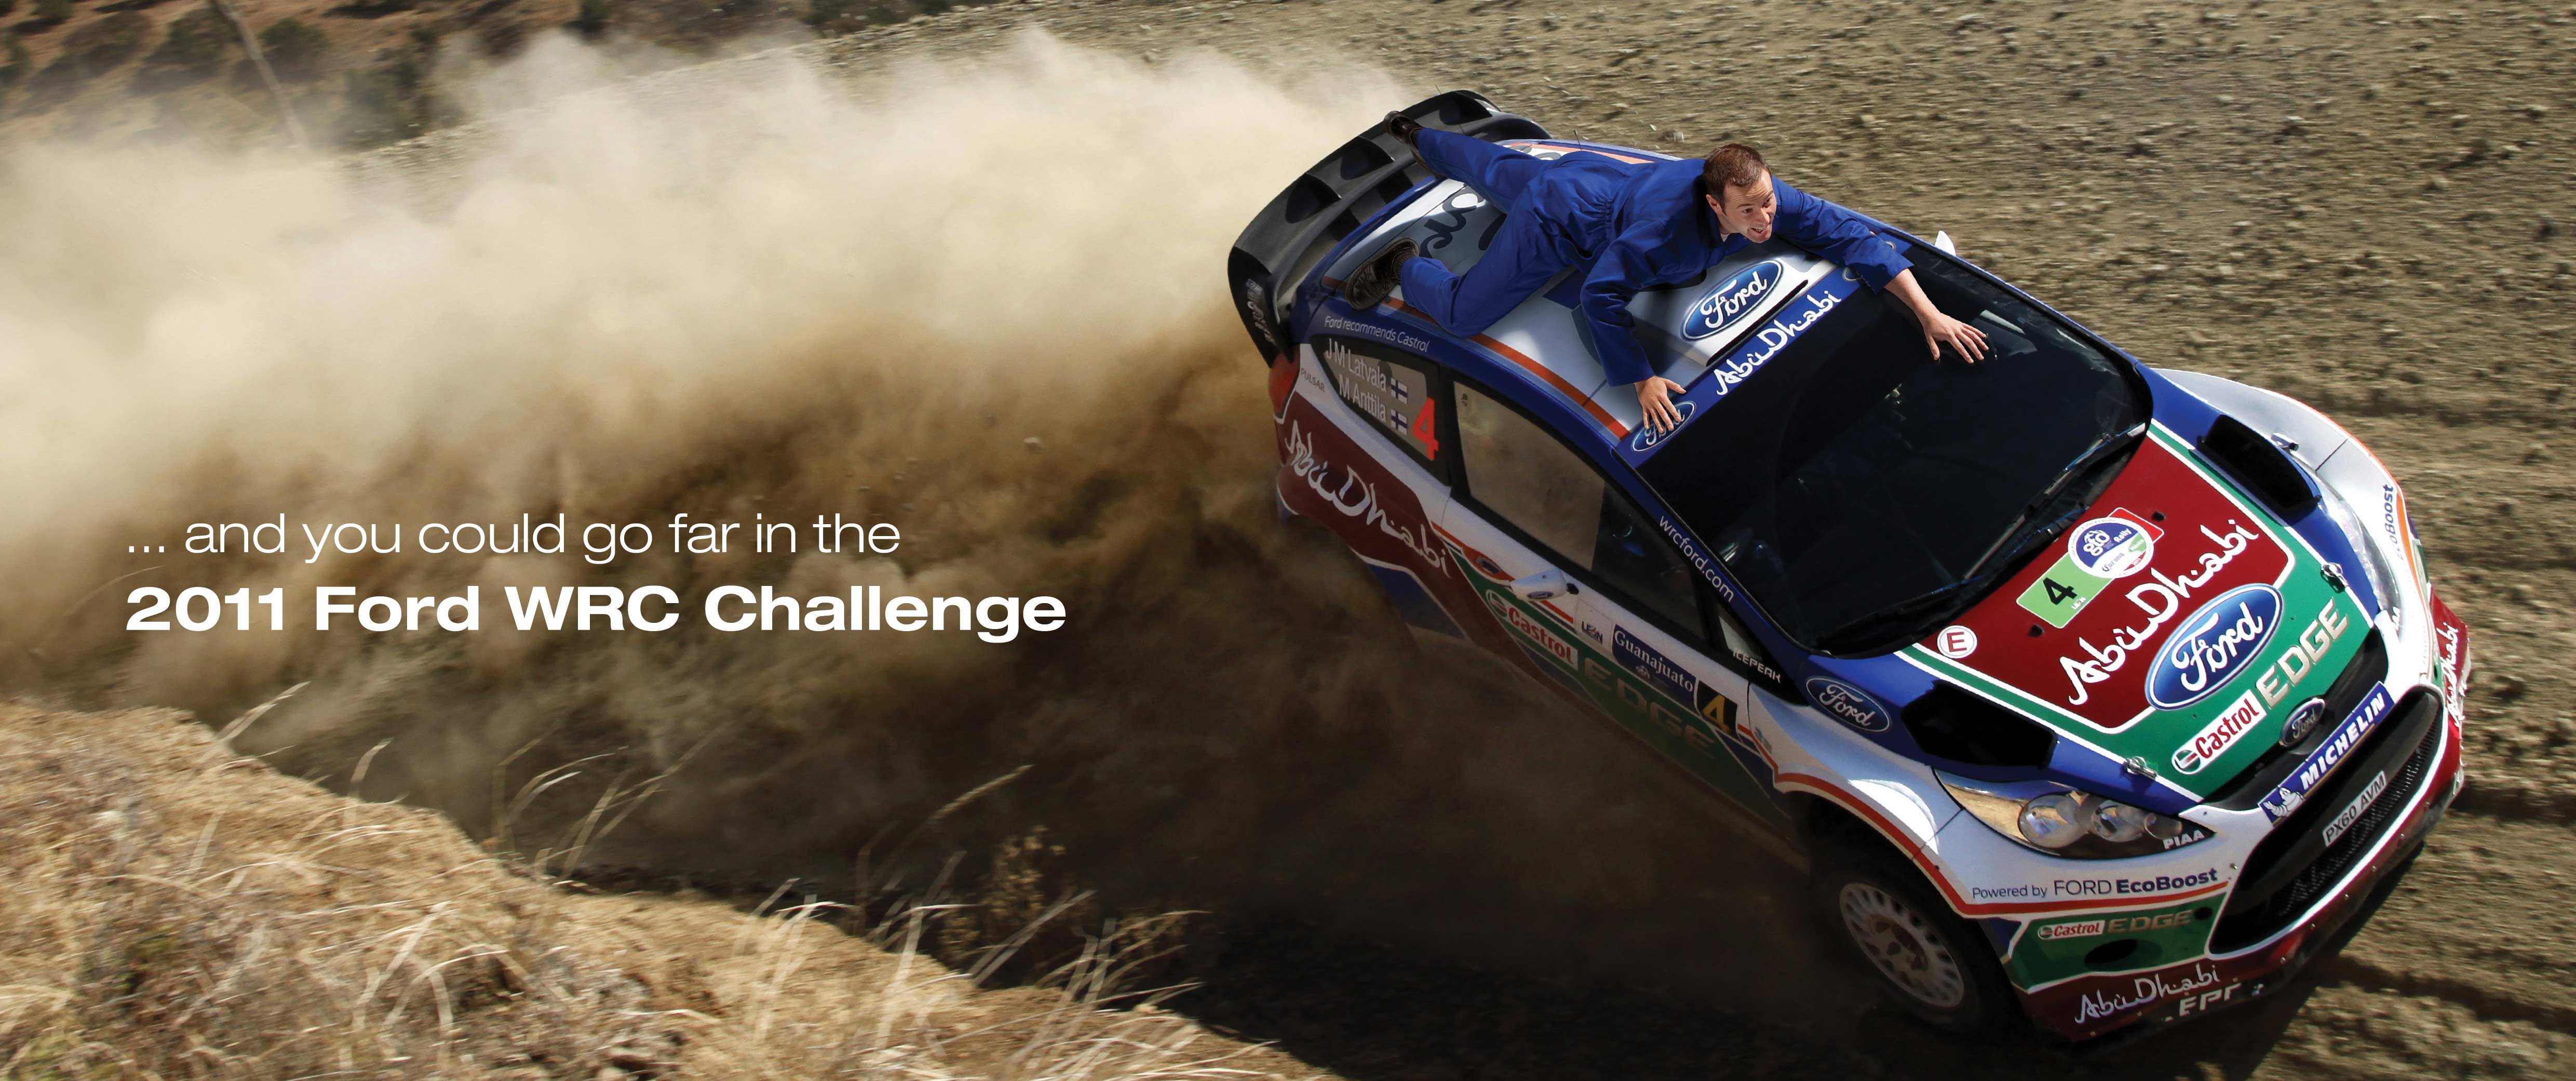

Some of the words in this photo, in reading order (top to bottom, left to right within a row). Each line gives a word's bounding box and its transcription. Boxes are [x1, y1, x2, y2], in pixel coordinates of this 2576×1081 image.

[1700, 271, 1768, 329] Ford
[1325, 316, 1342, 329] Ford
[1343, 319, 1396, 341] recommends
[1397, 331, 1430, 353] Castrol
[1300, 367, 1325, 392] PULSAR
[1326, 338, 1332, 360] J
[1334, 341, 1345, 368] M
[1348, 348, 1387, 393] Latvala
[1339, 374, 1350, 399] M
[1353, 386, 1387, 423] Anttila
[1412, 397, 1439, 461] 4
[2113, 528, 2132, 543] Rally
[1660, 516, 1734, 602] wrcford.com
[2043, 577, 2077, 605] 4
[1508, 607, 1573, 664] Castrol
[1947, 632, 1967, 652] E
[2171, 601, 2263, 691] Ford
[1614, 630, 1694, 692] Guanajuato
[1733, 648, 1781, 684] ICEPEAK
[2195, 698, 2260, 759] Castrol
[2255, 597, 2349, 710] EDGE
[1703, 694, 1730, 733] 4
[1819, 684, 1876, 726] Ford
[2291, 708, 2317, 739] Ford
[2300, 692, 2385, 790] MICHELIN
[2326, 807, 2357, 843] PX60
[2360, 775, 2386, 810] AVM
[2163, 830, 2205, 850] PIAA
[1973, 886, 2028, 899] Powered
[2032, 885, 2047, 898] by
[2054, 879, 2112, 896] FORD
[2116, 868, 2218, 894] EcoBoost
[2054, 923, 2100, 937] Castrol
[2108, 909, 2194, 933] EDGE
